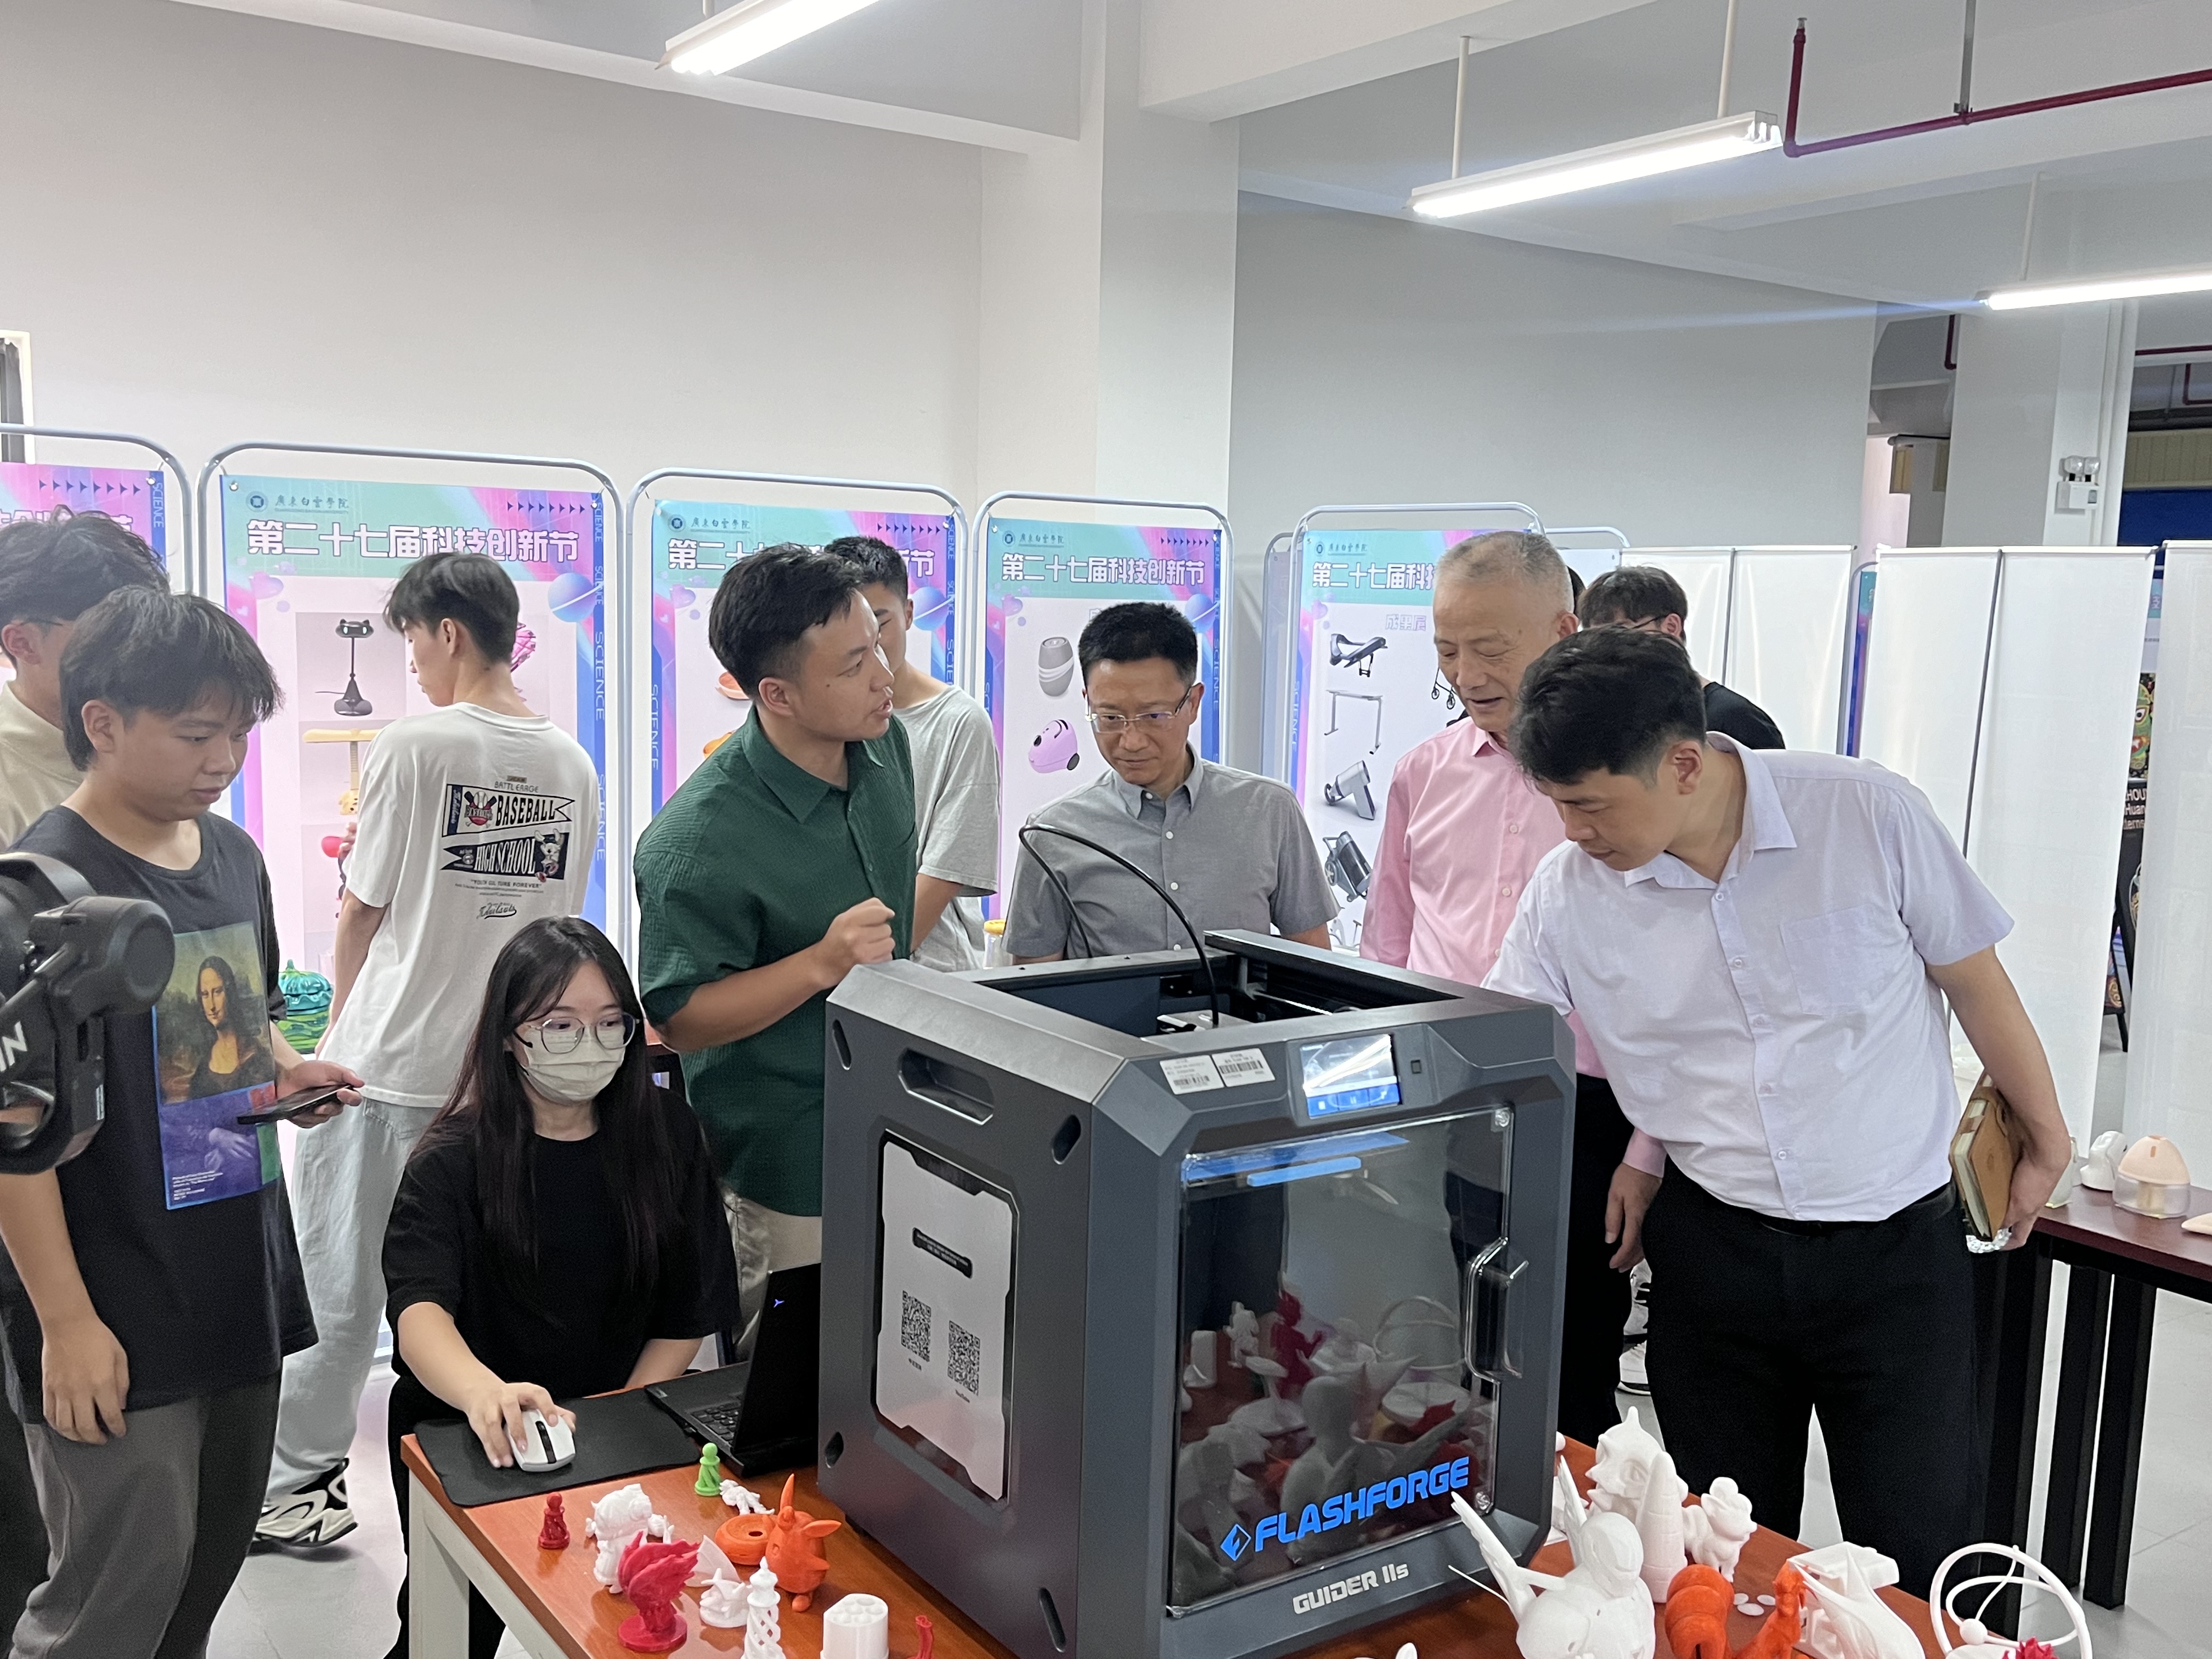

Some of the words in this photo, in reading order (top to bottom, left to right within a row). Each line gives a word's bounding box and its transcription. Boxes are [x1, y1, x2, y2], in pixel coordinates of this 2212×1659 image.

[152, 482, 164, 528] SCIENCE
[594, 501, 603, 543] SCIENCE
[247, 519, 579, 562] 第二十七届科技创新节
[595, 565, 603, 606] SCIENCE
[1002, 552, 1205, 585] 第二十七届科技创新节
[594, 631, 605, 721] SCIENCE
[1291, 680, 1300, 753] SCIENCE
[495, 795, 556, 826] BASEBALL
[597, 774, 606, 861] SCIENCE
[474, 844, 497, 872] HIGH
[495, 838, 535, 874] SCHOOL
[1255, 1457, 1470, 1552] FLASHFORGE
[1293, 1570, 1379, 1615] GUIDER
